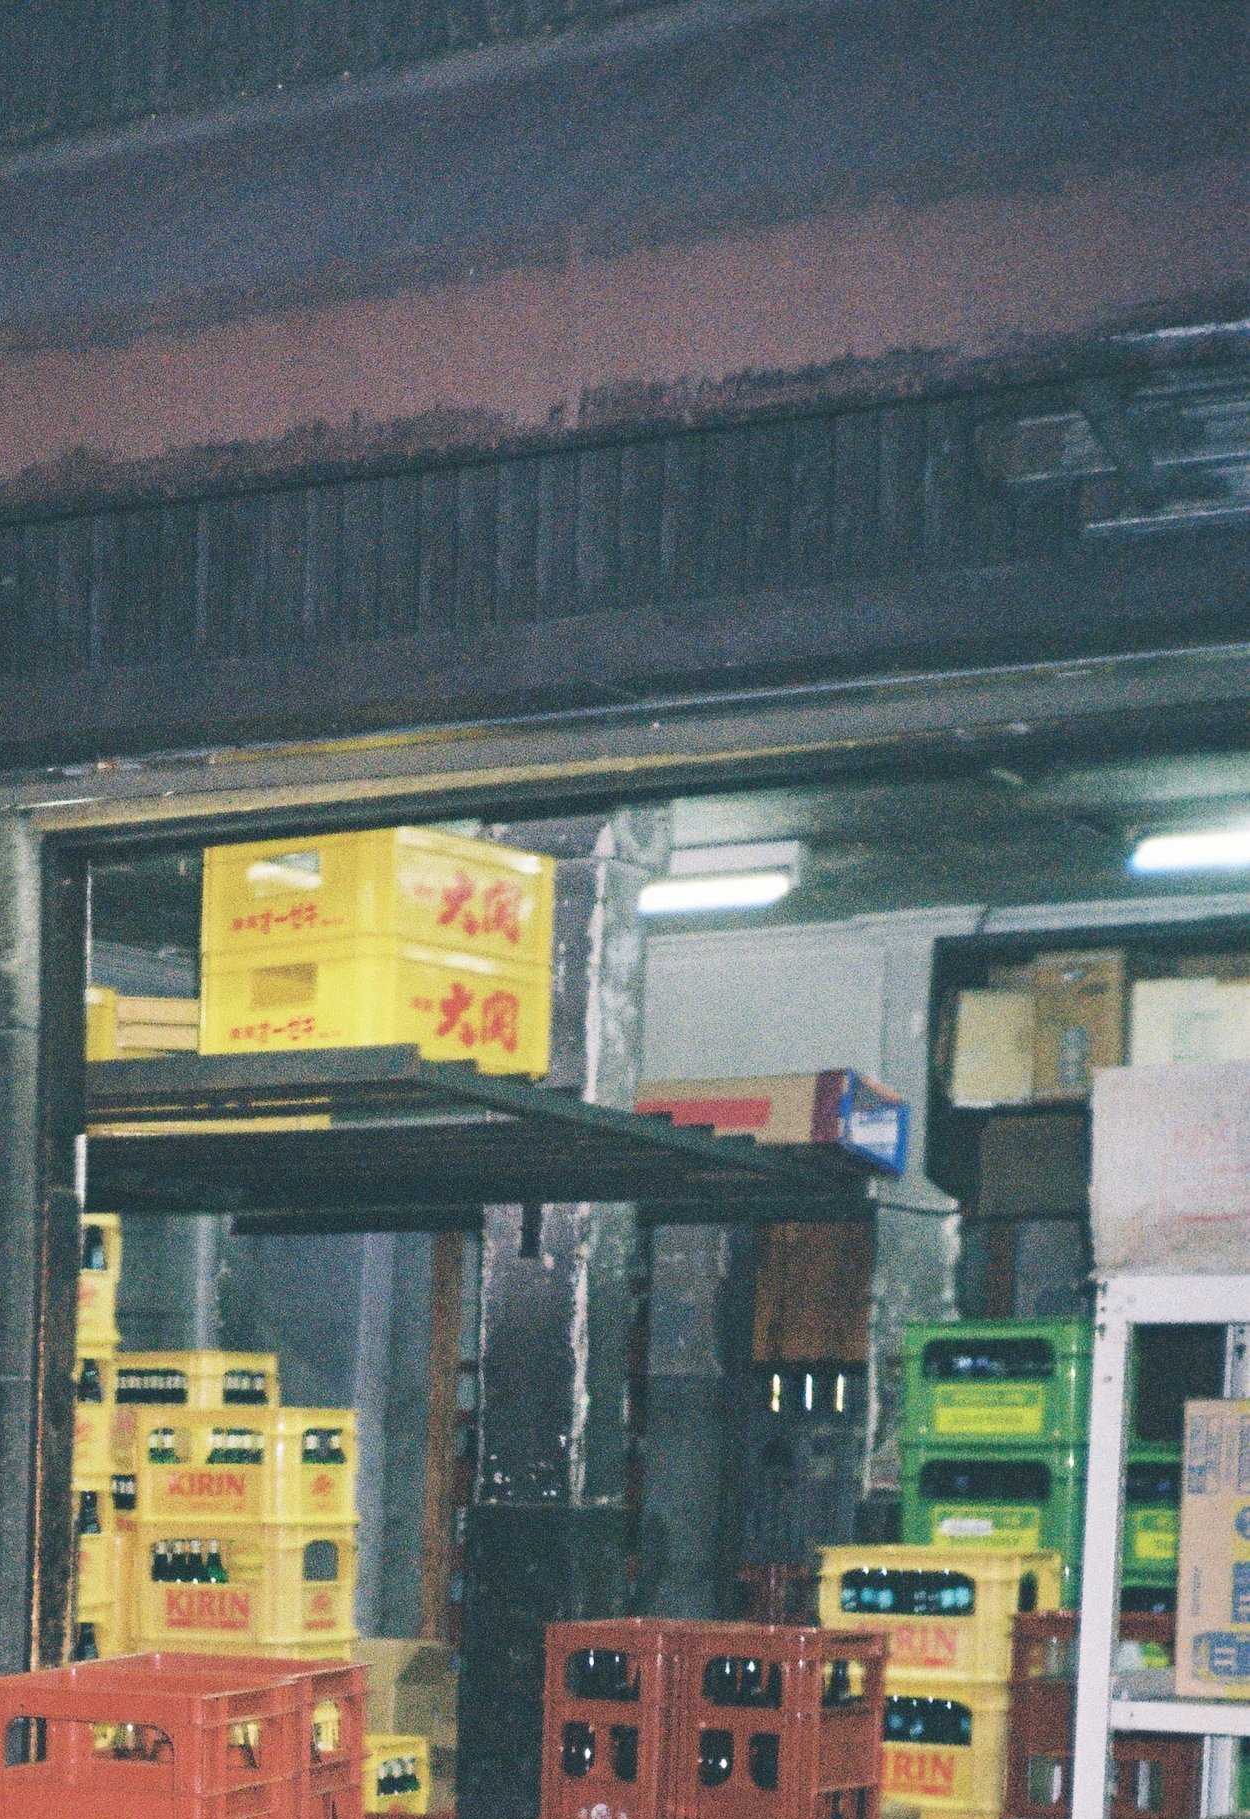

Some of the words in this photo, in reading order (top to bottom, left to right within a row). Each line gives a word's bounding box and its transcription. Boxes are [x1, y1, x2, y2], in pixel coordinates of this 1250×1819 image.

[167, 1472, 246, 1497] KIRIN
[165, 1589, 250, 1619] KIRIN
[892, 1624, 956, 1656] RIN
